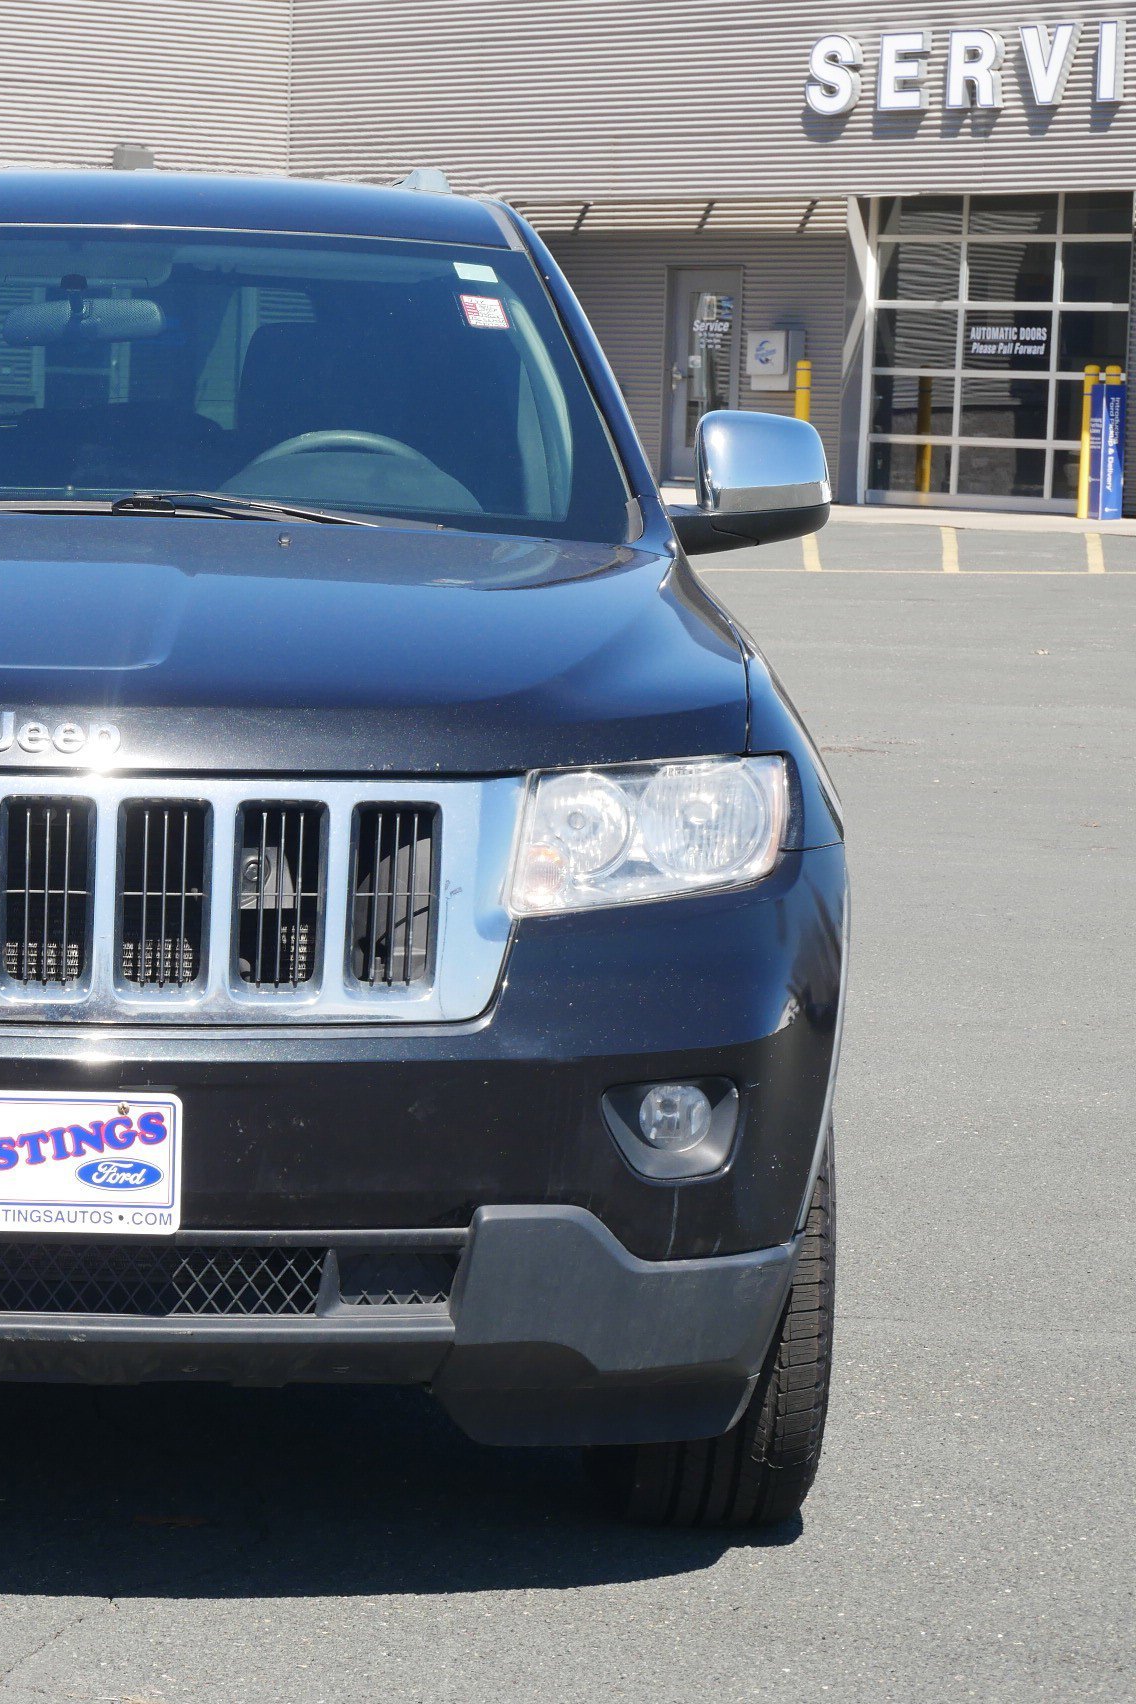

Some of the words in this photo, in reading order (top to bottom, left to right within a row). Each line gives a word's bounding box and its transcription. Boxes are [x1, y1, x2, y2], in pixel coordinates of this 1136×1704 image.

[805, 17, 1126, 116] SERVI
[692, 319, 730, 332] Service
[970, 327, 1018, 341] AUTOMATIC
[1019, 327, 1047, 341] DOORS
[971, 342, 997, 354] Please
[997, 342, 1014, 355] Pull
[1014, 342, 1046, 355] Forward
[1113, 397, 1121, 445] Introducing
[1105, 456, 1115, 493] Delivery
[91, 1161, 147, 1186] Ford
